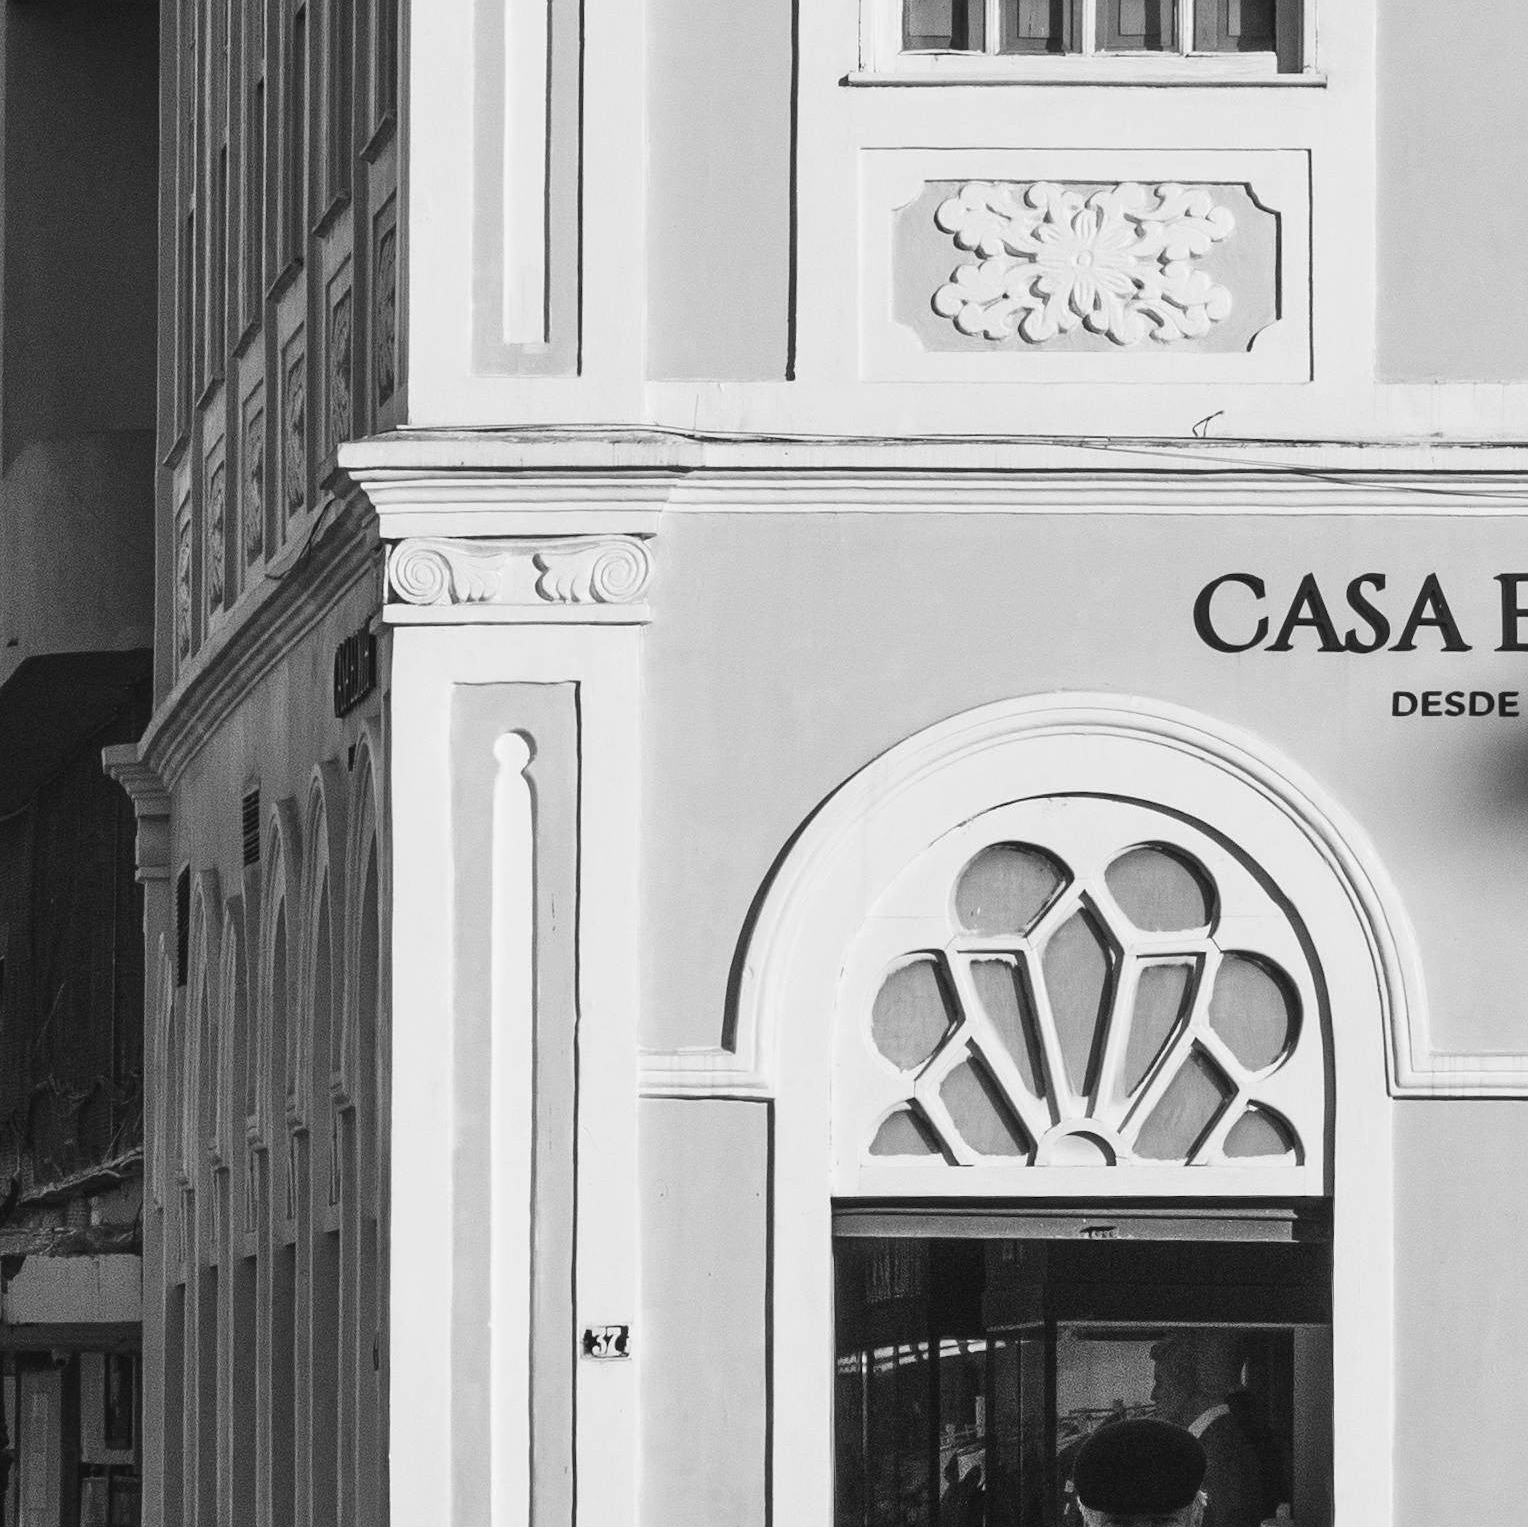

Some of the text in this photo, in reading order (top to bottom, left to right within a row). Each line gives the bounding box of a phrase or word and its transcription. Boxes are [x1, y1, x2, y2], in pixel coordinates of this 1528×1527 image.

[1193, 571, 1472, 654] CASA
[1391, 690, 1520, 718] DESDE
[591, 1325, 622, 1357] 37
